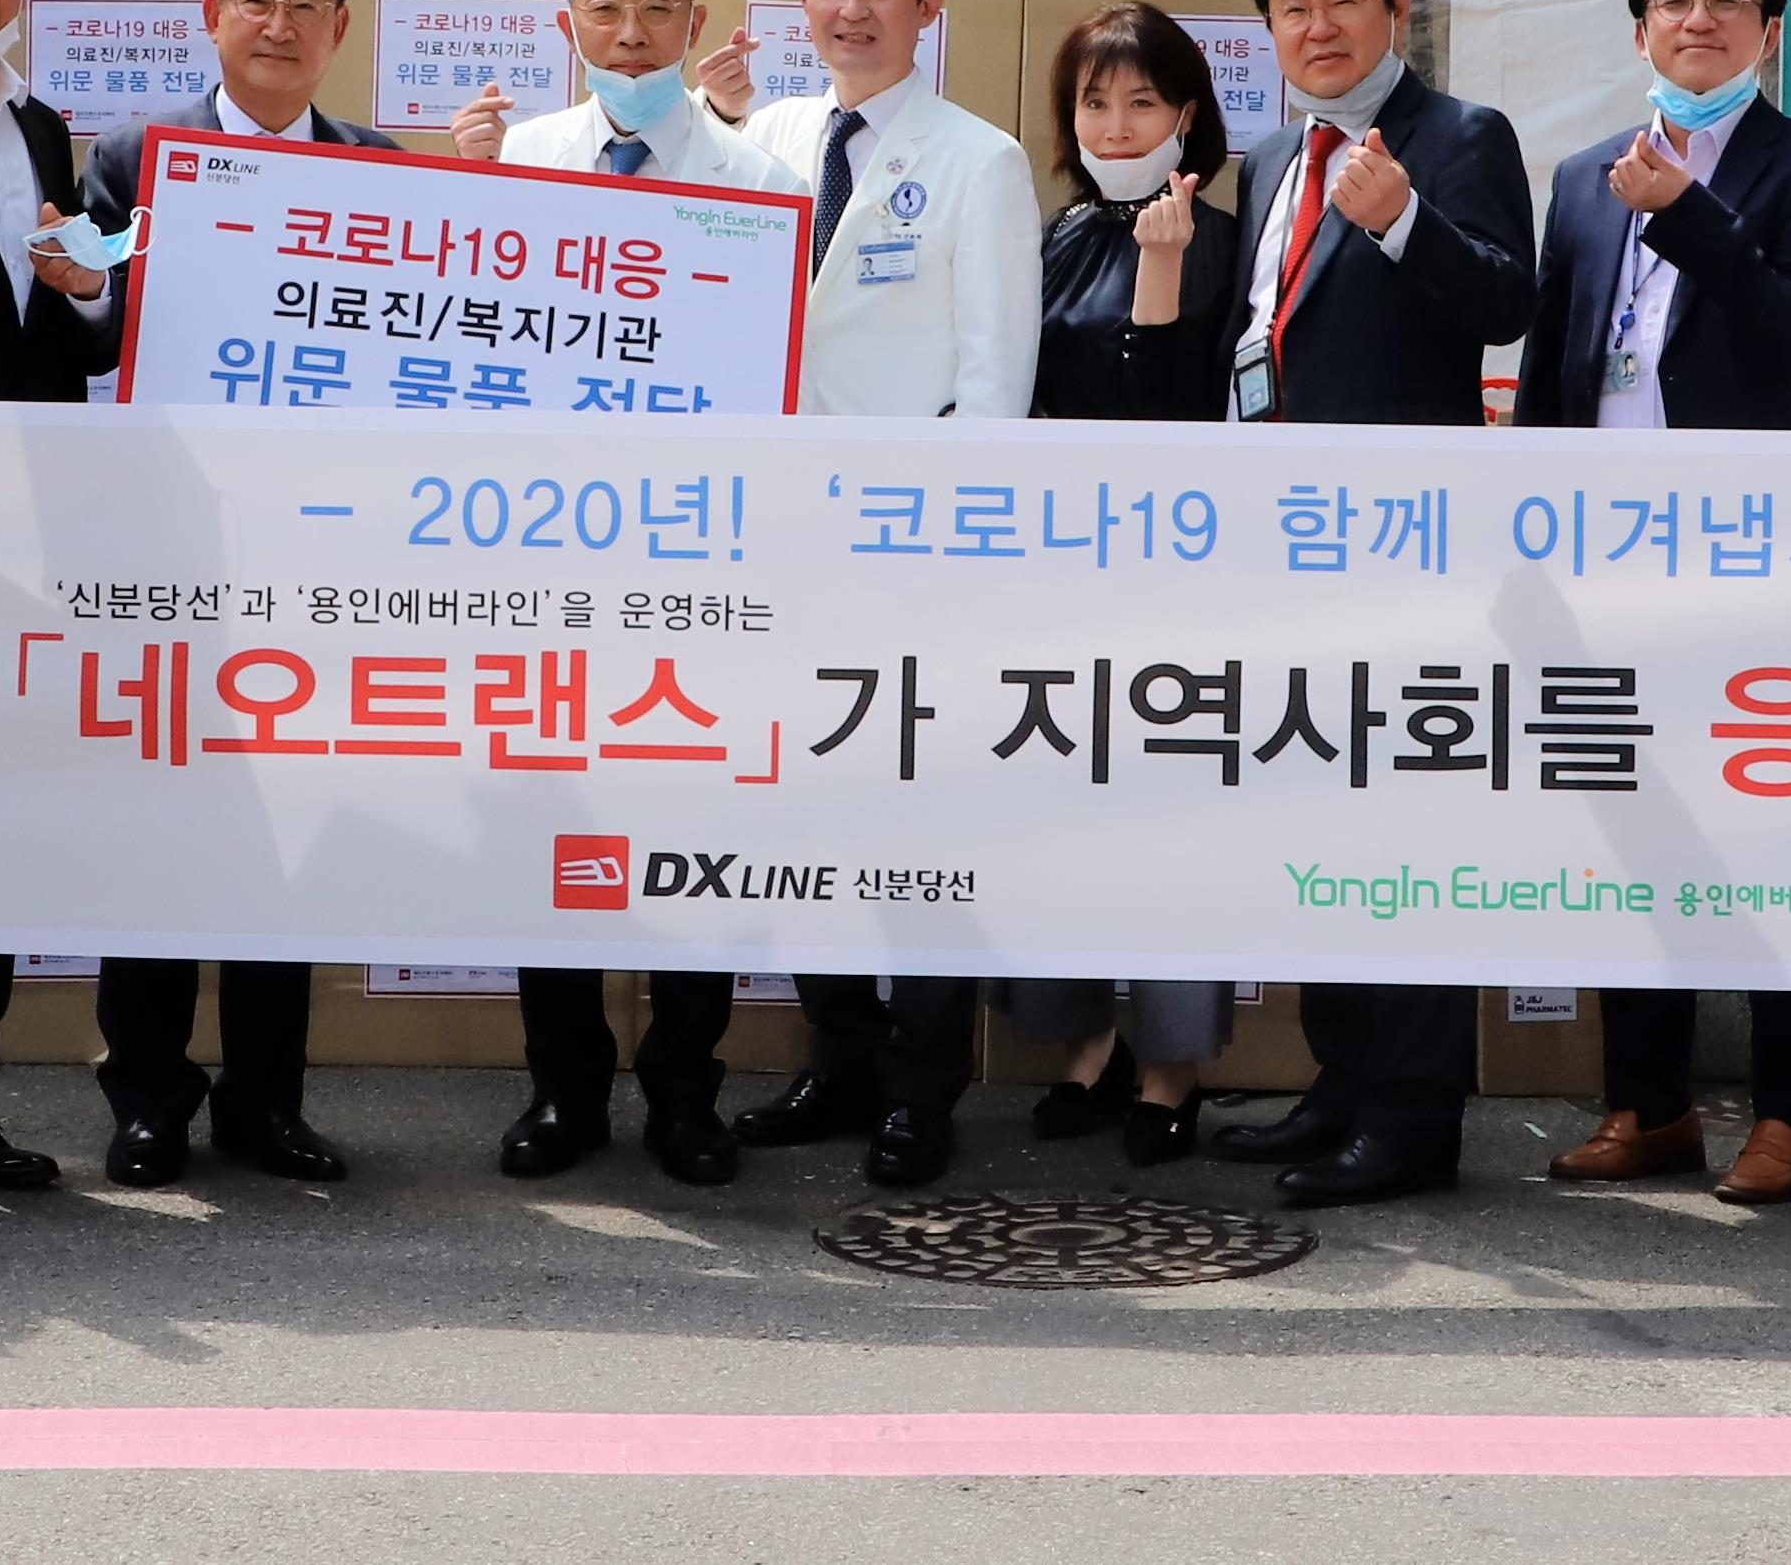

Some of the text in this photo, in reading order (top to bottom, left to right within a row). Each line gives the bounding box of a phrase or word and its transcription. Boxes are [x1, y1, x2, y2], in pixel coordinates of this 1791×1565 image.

[66, 20, 189, 39] 코로나19 대응
[414, 13, 537, 35] 코로나19 대응
[66, 47, 189, 63] 의료진/복지기관
[414, 40, 537, 59] 의료진/복지기관
[1215, 38, 1251, 58] 대응
[49, 70, 206, 93] 위문 물품 전달
[396, 63, 553, 89] 위문 물품 전달
[765, 74, 808, 96] 위문
[1223, 90, 1266, 111] 전달
[277, 208, 527, 281] 코로나19
[555, 235, 667, 300] 대응
[273, 281, 662, 364] 의료진/복지기관
[209, 338, 351, 408] 위문
[408, 475, 746, 561] 2020년!
[826, 473, 1219, 569] ‘코로나19
[1277, 484, 1450, 575] 함께
[619, 592, 775, 632] 운영하는
[992, 657, 1654, 792] 지역사회를
[852, 868, 976, 903] 신분당선
[1284, 862, 1654, 920] YongIn EverLine
